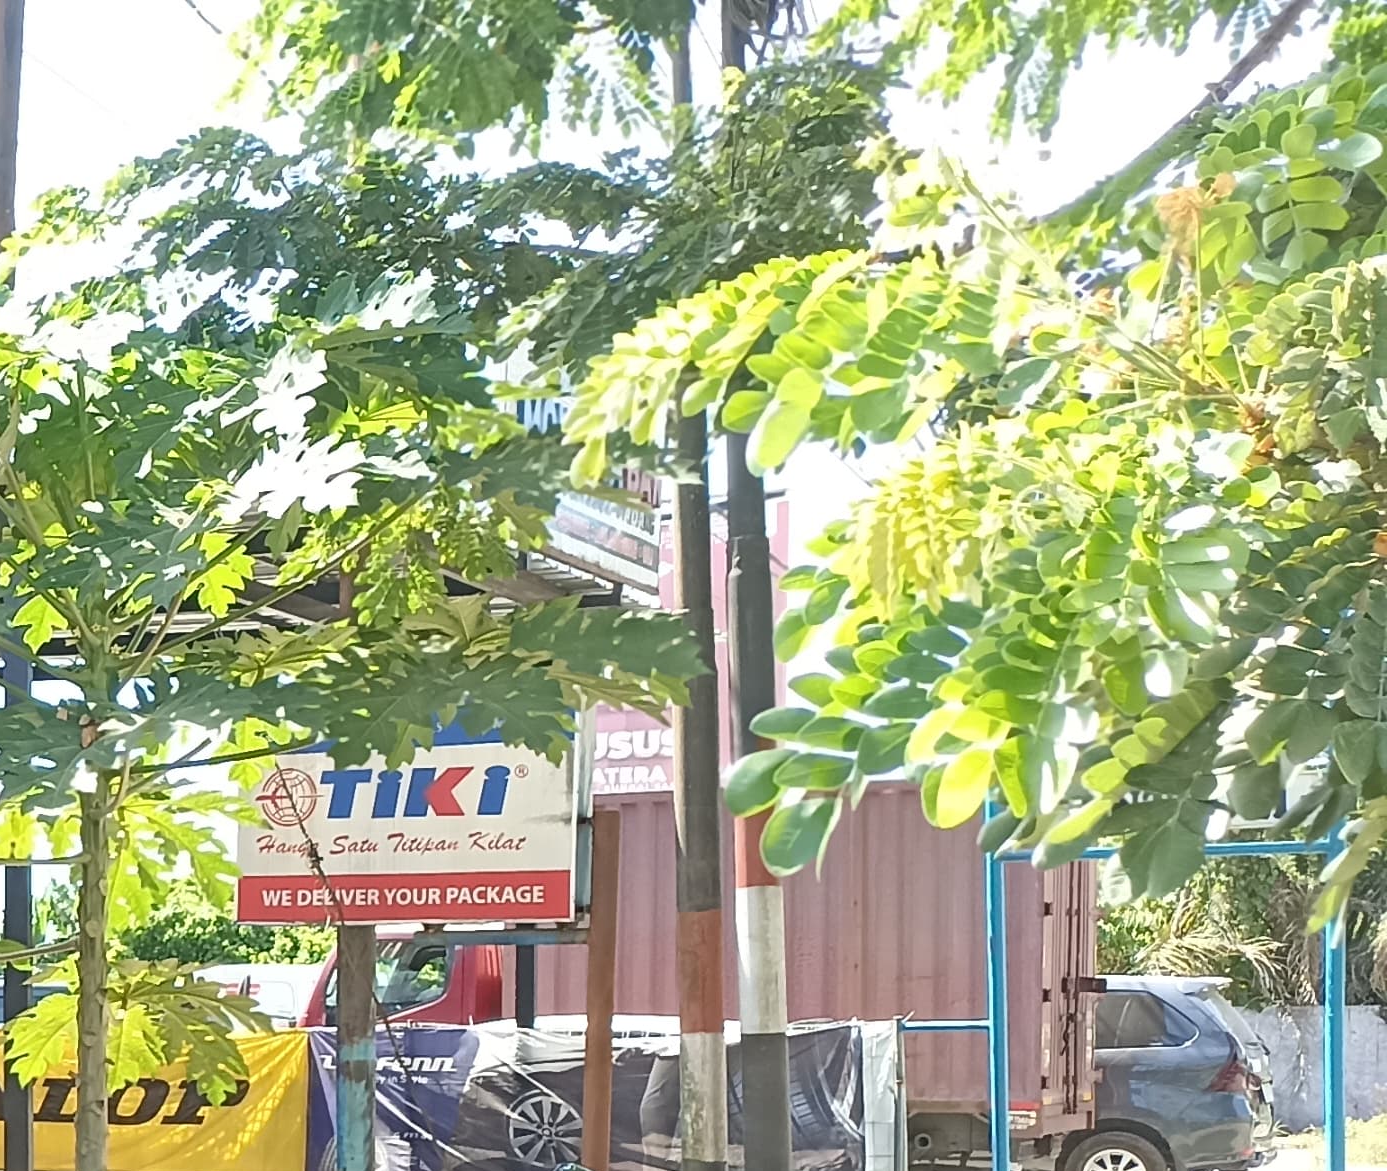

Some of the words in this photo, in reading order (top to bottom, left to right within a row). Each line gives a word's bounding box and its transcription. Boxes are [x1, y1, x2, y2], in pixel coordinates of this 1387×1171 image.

[329, 834, 380, 856] Satu
[387, 832, 460, 857] Titipan
[468, 831, 528, 851] Kilat
[262, 889, 292, 906] WE
[297, 887, 380, 906] DELIVER
[384, 886, 441, 905] YOUR
[446, 885, 545, 904] PACKAGE
